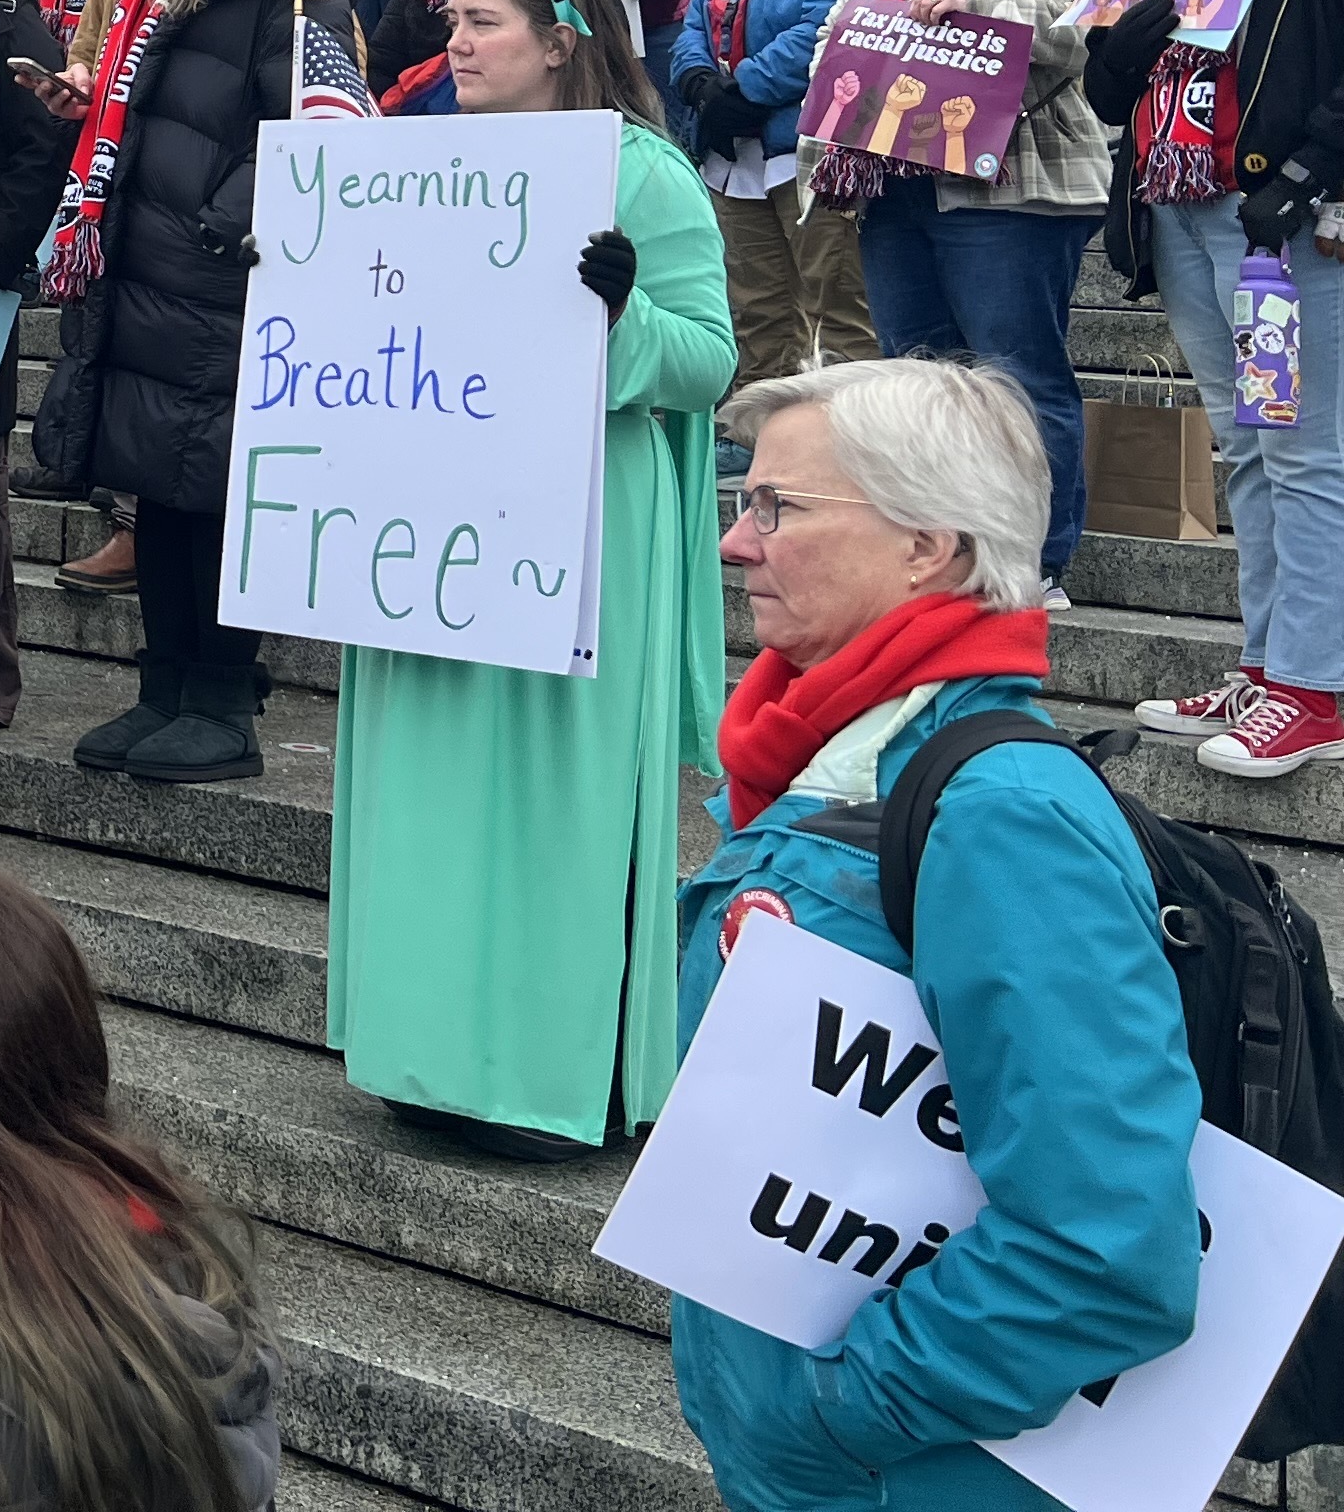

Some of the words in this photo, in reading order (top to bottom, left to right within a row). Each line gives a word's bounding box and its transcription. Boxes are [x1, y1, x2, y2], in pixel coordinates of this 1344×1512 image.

[837, 27, 903, 55] racial
[900, 38, 1004, 76] justice
[850, 6, 891, 29] Tax
[980, 28, 1008, 54] is
[369, 248, 405, 298] to
[251, 315, 497, 420] Breathe
